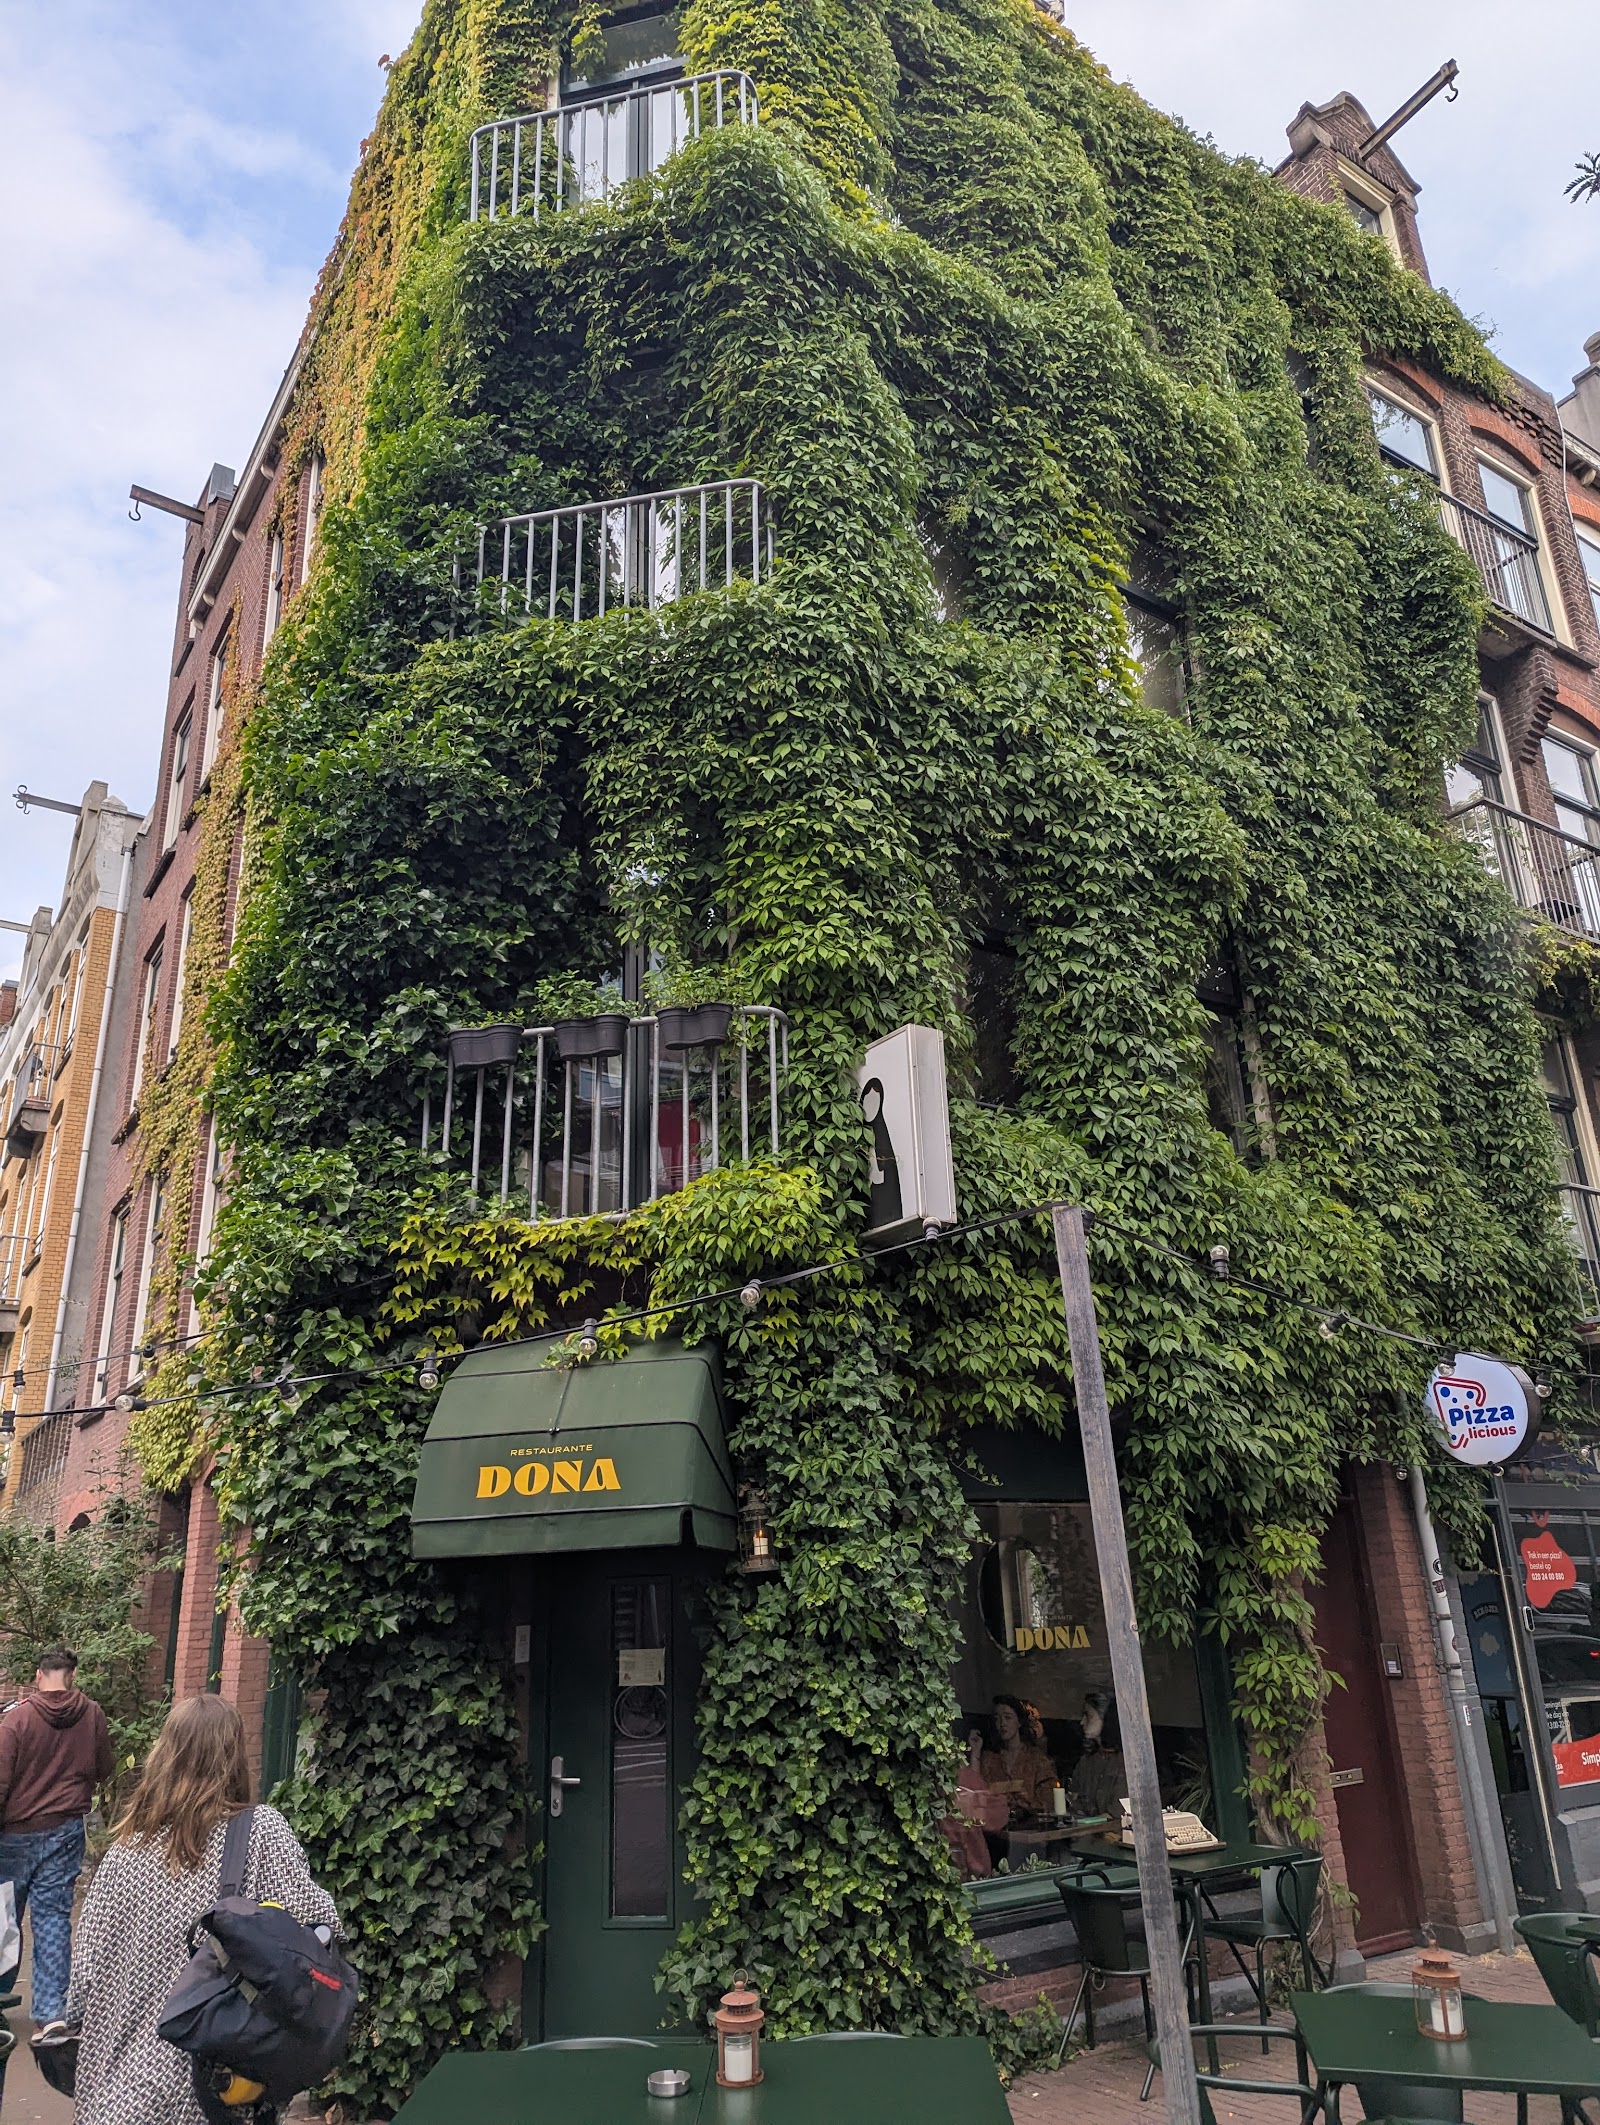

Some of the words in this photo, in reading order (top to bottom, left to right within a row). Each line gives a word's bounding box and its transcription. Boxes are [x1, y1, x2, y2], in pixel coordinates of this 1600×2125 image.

[1449, 1405, 1514, 1426] Pizza
[1468, 1425, 1516, 1439] licious
[510, 1444, 593, 1456] RESTAURANTE
[476, 1458, 621, 1498] DONA
[1529, 1562, 1544, 1570] bestel
[1545, 1564, 1551, 1572] op
[1015, 1625, 1091, 1651] DONA
[1553, 1711, 1561, 1720] dag
[1581, 1751, 1600, 1767] Simp
